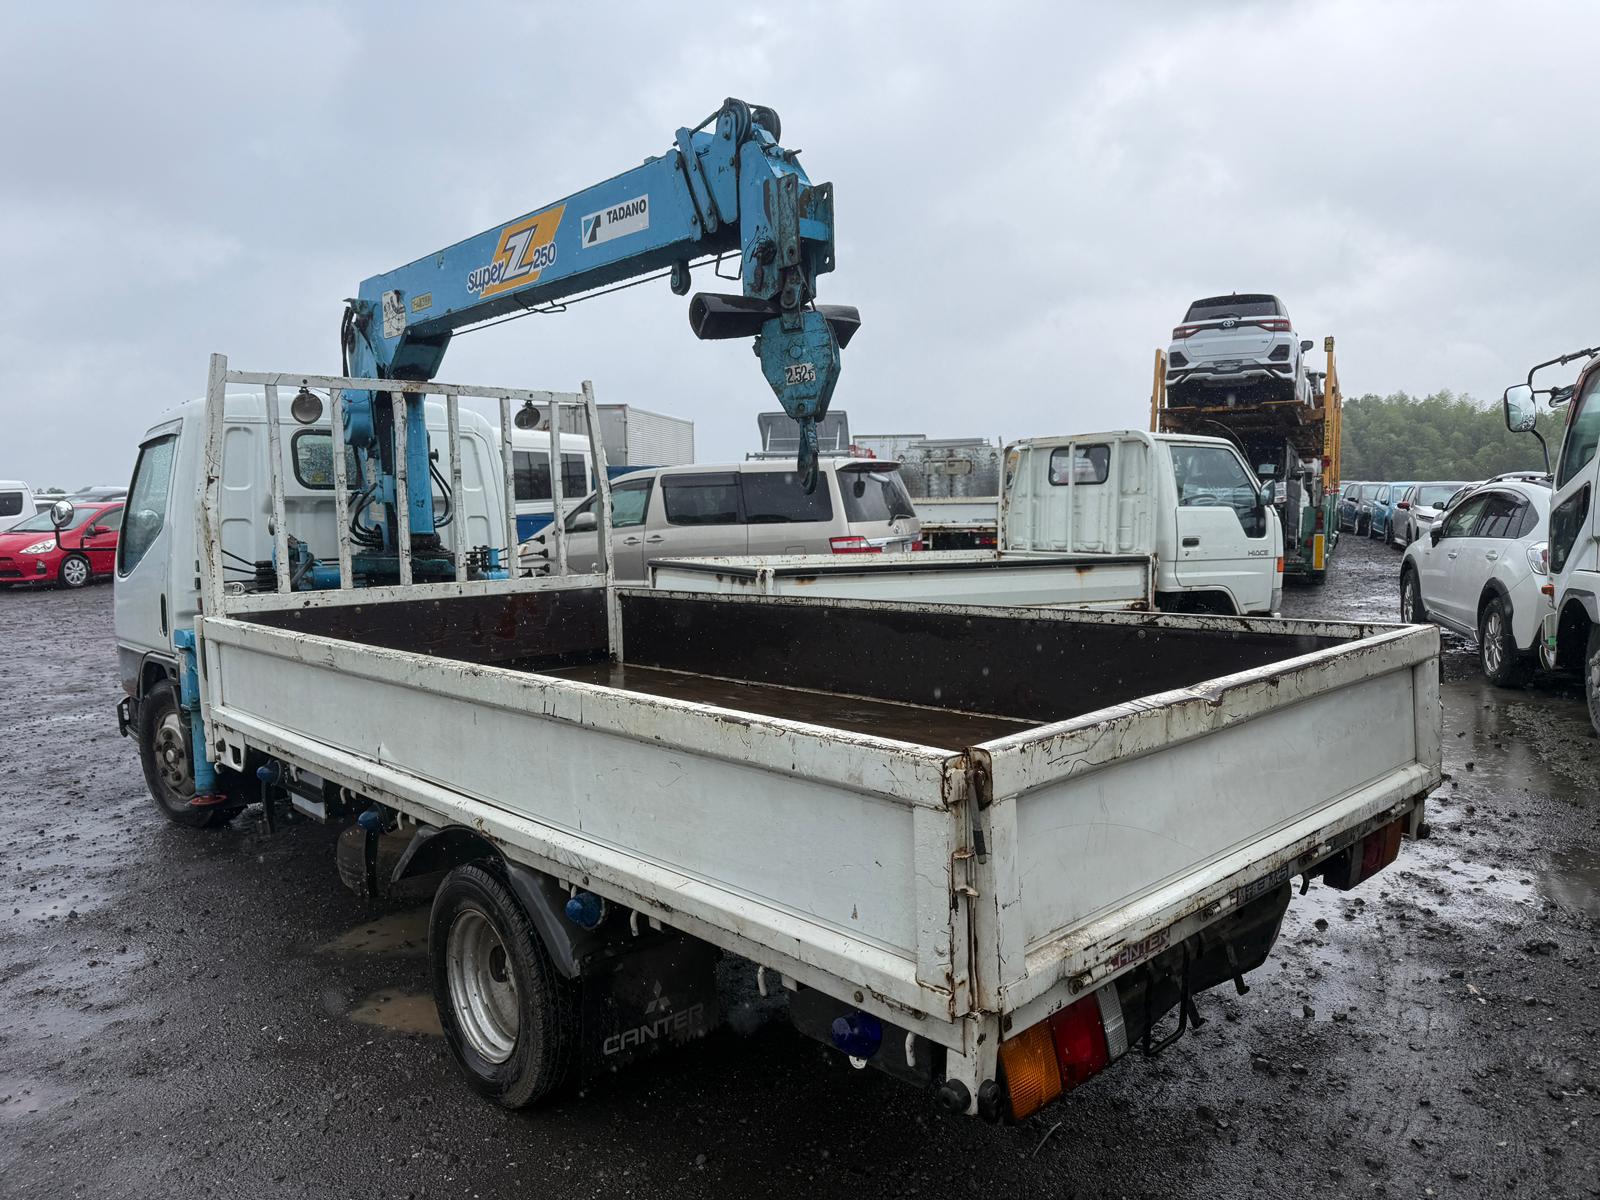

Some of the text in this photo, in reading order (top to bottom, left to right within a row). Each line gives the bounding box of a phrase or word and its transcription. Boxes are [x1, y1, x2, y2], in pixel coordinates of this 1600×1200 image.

[606, 198, 647, 225] TADANO
[467, 223, 556, 292] super Z 250
[602, 1002, 704, 1056] CANTER
